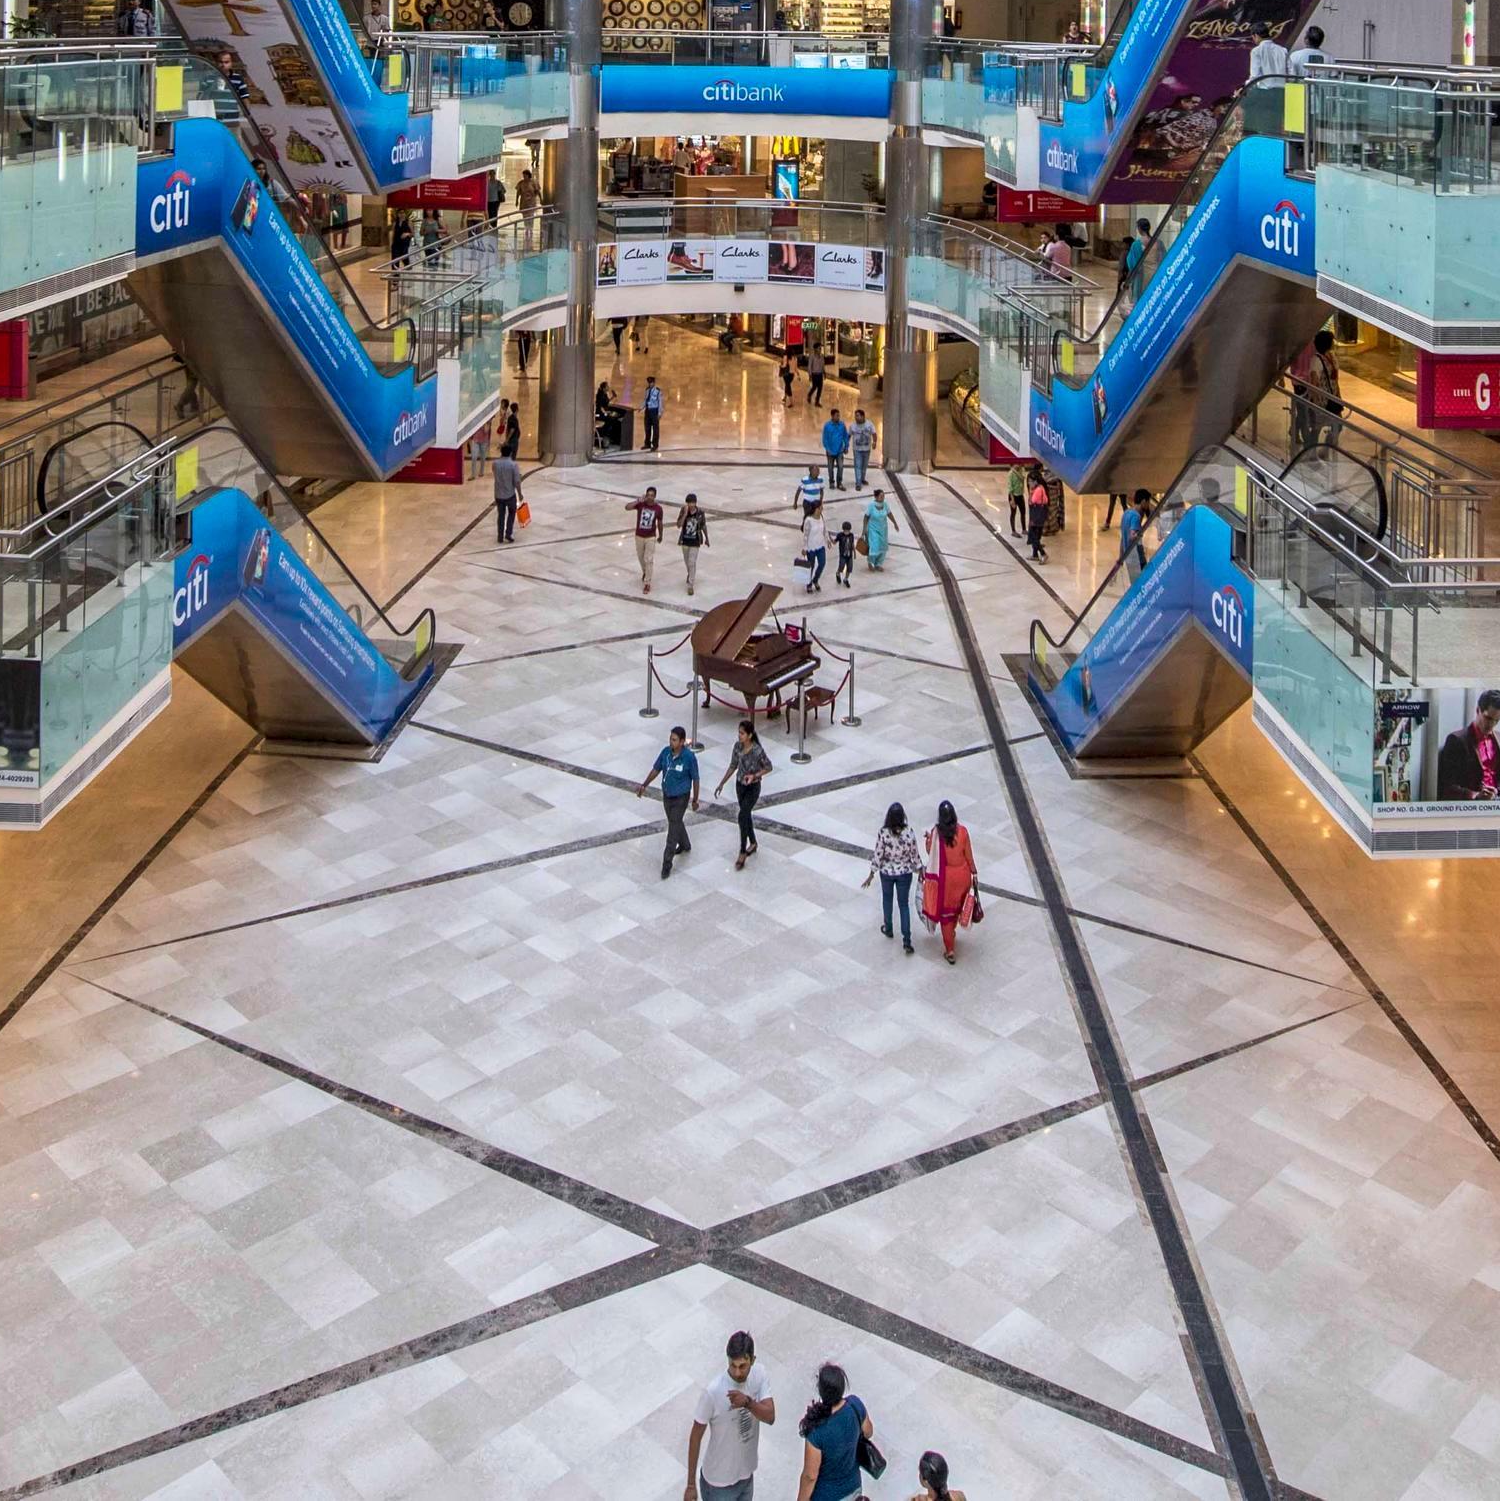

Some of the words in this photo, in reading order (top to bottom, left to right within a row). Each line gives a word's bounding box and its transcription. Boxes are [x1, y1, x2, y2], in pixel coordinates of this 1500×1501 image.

[1187, 18, 1295, 39] ZANGOA
[703, 80, 785, 102] citibank
[390, 135, 425, 166] citibank
[1046, 143, 1079, 174] citibank
[150, 178, 191, 233] citi
[1260, 207, 1299, 257] citi
[624, 248, 659, 261] Clarks
[721, 246, 760, 258] Clarks
[822, 251, 858, 265] Clarks
[1166, 242, 1188, 282] Samsung
[1453, 388, 1471, 398] LEVEL
[1475, 372, 1490, 411] G
[393, 408, 428, 446] citibank
[1035, 412, 1067, 458] citibank
[172, 562, 208, 627] citi
[1211, 589, 1242, 649] citi
[1377, 805, 1395, 813] SHOP
[1426, 804, 1455, 812] GROUND
